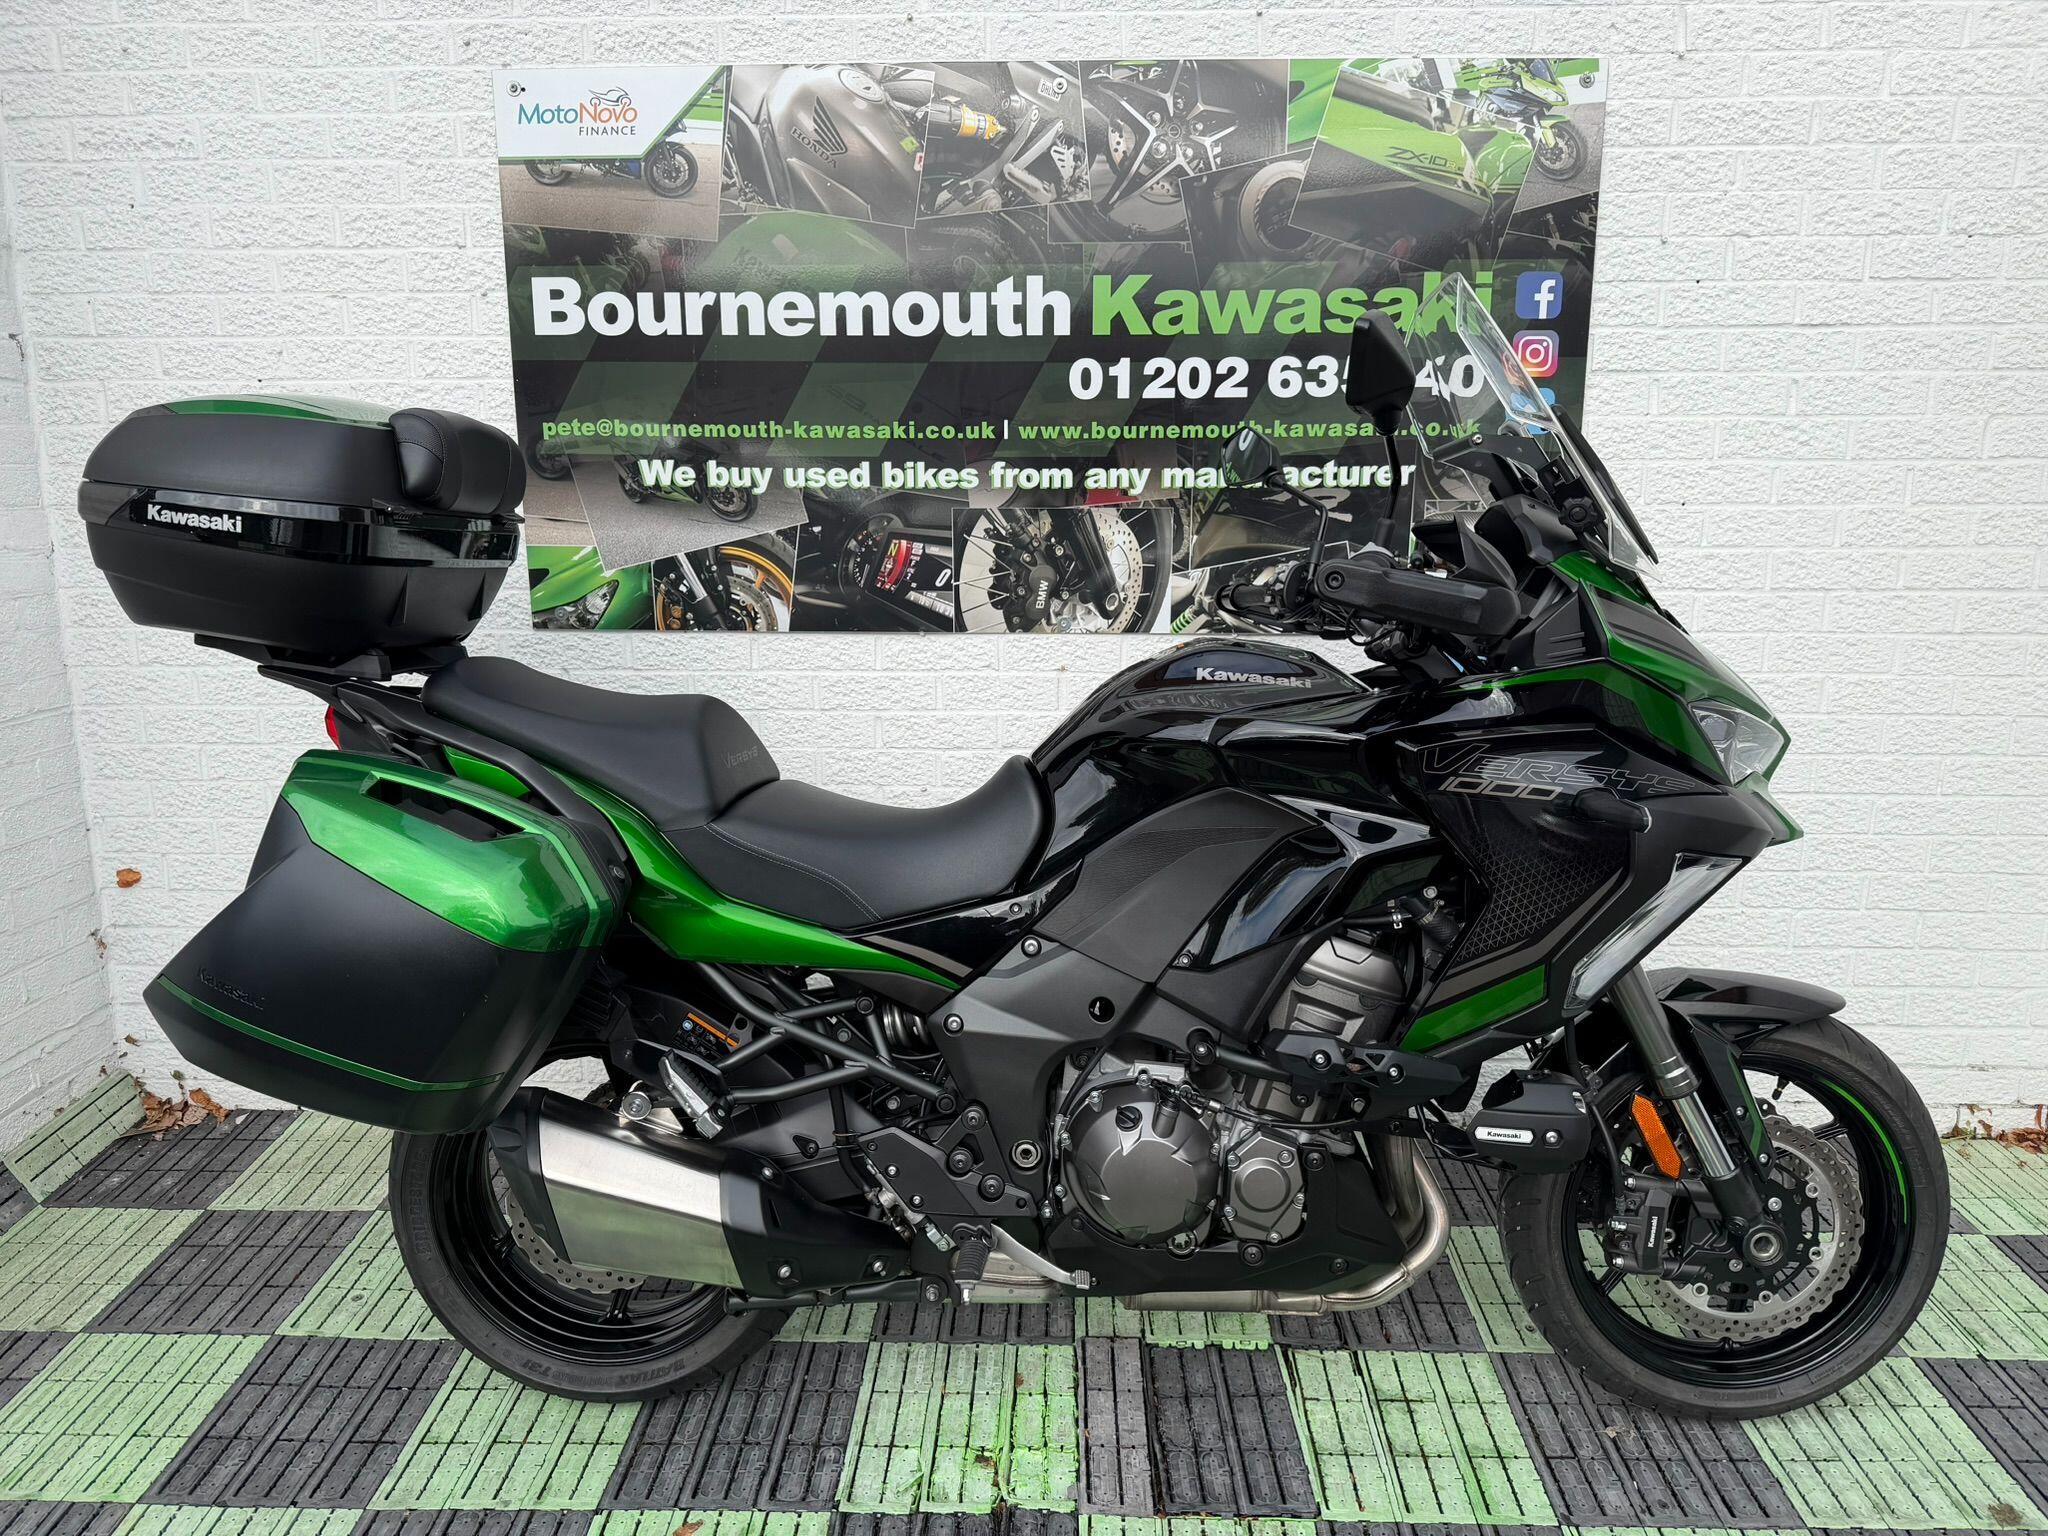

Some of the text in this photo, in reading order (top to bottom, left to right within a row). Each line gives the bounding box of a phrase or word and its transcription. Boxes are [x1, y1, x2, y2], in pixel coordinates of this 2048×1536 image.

[518, 102, 638, 125] MotoNovo
[579, 125, 636, 136] FINANCE
[790, 127, 839, 169] HONDA
[531, 271, 1494, 337] Bournemouth Kawasaki
[1069, 355, 1485, 400] 01202 6340
[542, 418, 1480, 440] pete@bournemouth-kawasaki.co.uk www.bournemouh-kawasa.co.uk
[638, 459, 1417, 496] We buy used bikes from any maacturer
[147, 503, 242, 534] Kawasaki
[1035, 580, 1049, 609] BMW
[1195, 667, 1312, 689] Kawasaki
[1422, 743, 1696, 793] VERSYS
[1438, 776, 1563, 801] 1000
[198, 966, 265, 1011] Kawasaki
[1486, 1130, 1522, 1140] Kawasaki
[1647, 1215, 1659, 1248] Kawasaki
